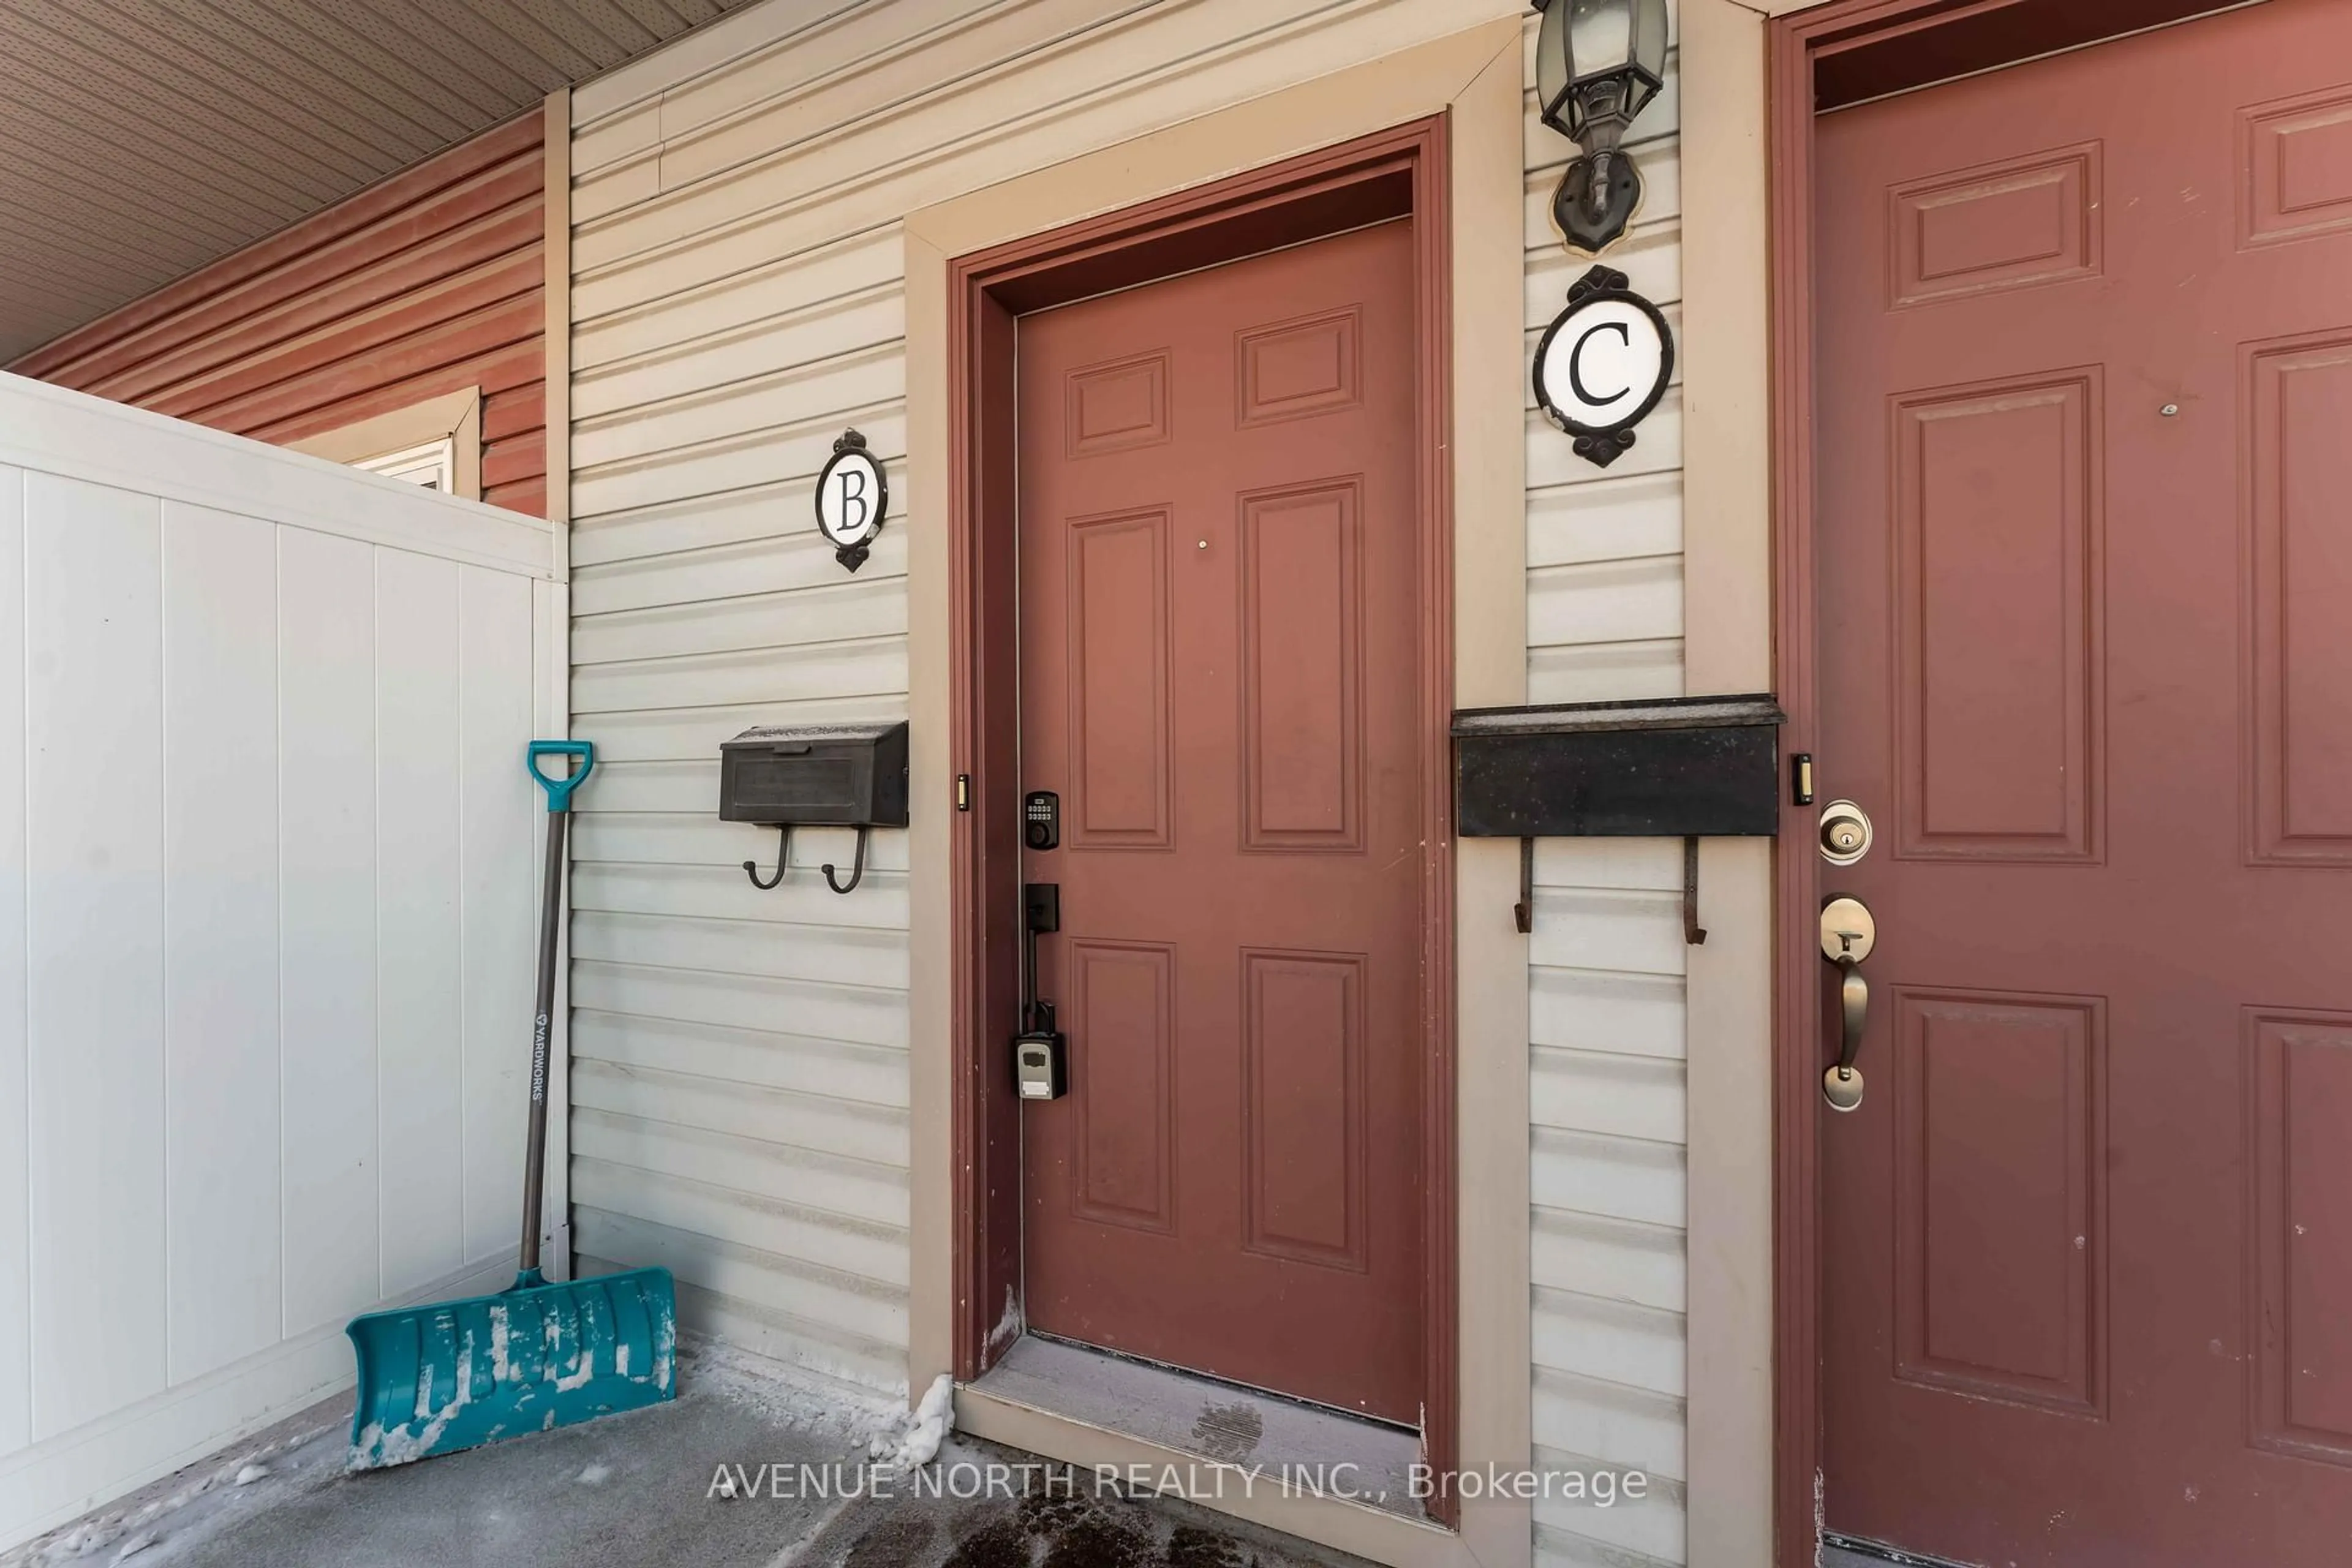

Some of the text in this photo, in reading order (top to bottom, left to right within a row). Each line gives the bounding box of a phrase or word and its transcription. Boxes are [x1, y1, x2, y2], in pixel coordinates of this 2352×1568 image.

[1569, 322, 1630, 407] C
[836, 470, 867, 532] B
[532, 1027, 546, 1101] YARDWORKS
